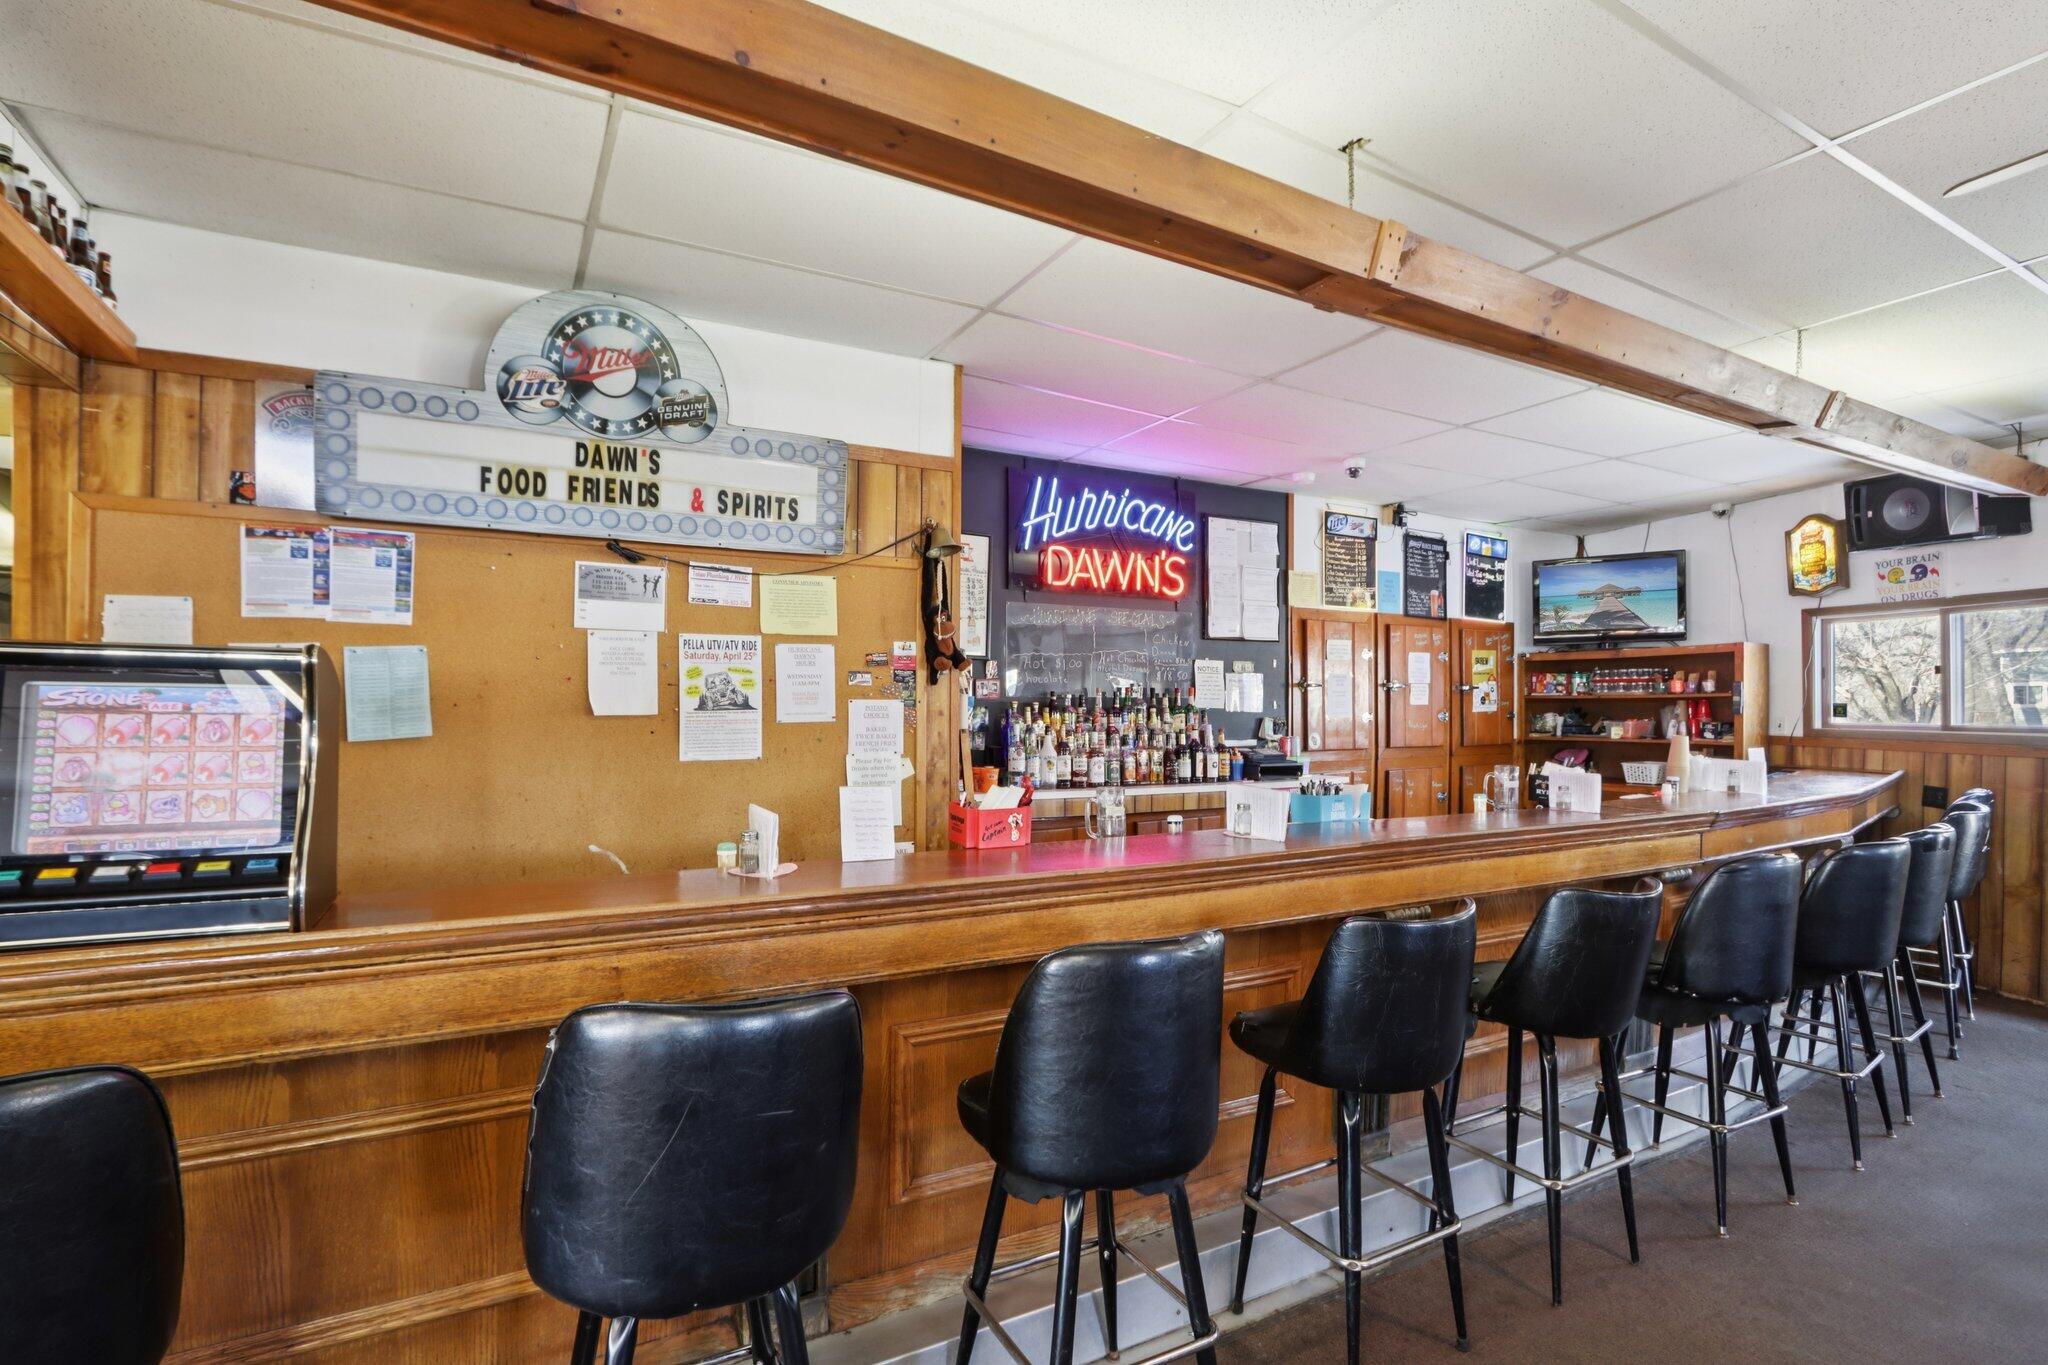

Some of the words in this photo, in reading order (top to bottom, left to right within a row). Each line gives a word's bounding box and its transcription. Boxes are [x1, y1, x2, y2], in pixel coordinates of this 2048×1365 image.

[563, 338, 654, 378] Miller
[504, 378, 567, 403] Lite
[657, 401, 710, 414] GENUINE
[664, 409, 704, 420] DRAFT
[575, 441, 661, 475] DAWN'S
[480, 466, 547, 497] FOOD
[567, 472, 660, 508] FRIENDS
[690, 487, 704, 513] &
[717, 489, 799, 522] SPIRITS
[1023, 475, 1196, 552] Hurricane
[1875, 558, 1903, 570] YOUR
[1906, 551, 1941, 565] BRAIN
[1046, 545, 1187, 597] DAWN'S
[1877, 585, 1905, 595] YOUR
[1881, 595, 1896, 604] ON
[1901, 589, 1939, 601] DRUGS
[683, 639, 705, 650] PELLA
[707, 639, 739, 650] UTV/ATV
[741, 640, 758, 651] RIDE
[683, 650, 722, 661] Saturday,
[722, 651, 742, 662] April
[1023, 656, 1047, 670] Hot
[43, 689, 144, 708] STONE
